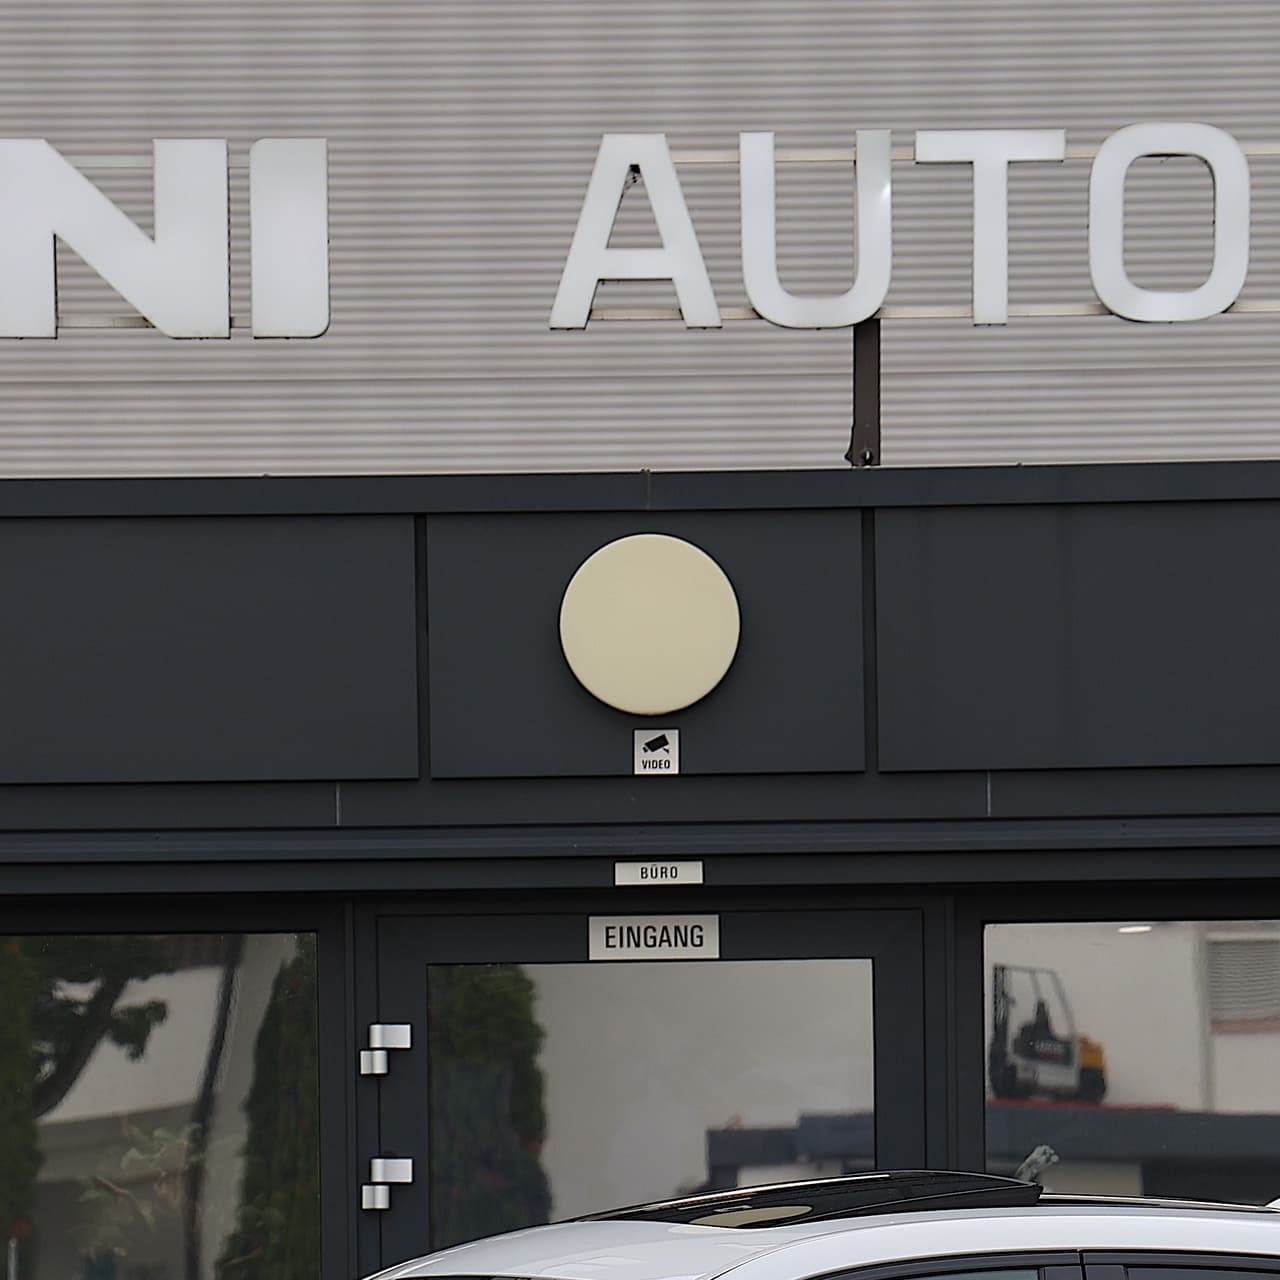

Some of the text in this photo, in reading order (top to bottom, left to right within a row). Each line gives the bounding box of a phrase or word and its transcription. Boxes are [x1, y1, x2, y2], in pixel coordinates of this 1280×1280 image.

[549, 121, 1252, 329] AUTO
[642, 760, 671, 769] VIDEO
[640, 864, 678, 879] BÜRO
[605, 924, 704, 948] EINGANG
